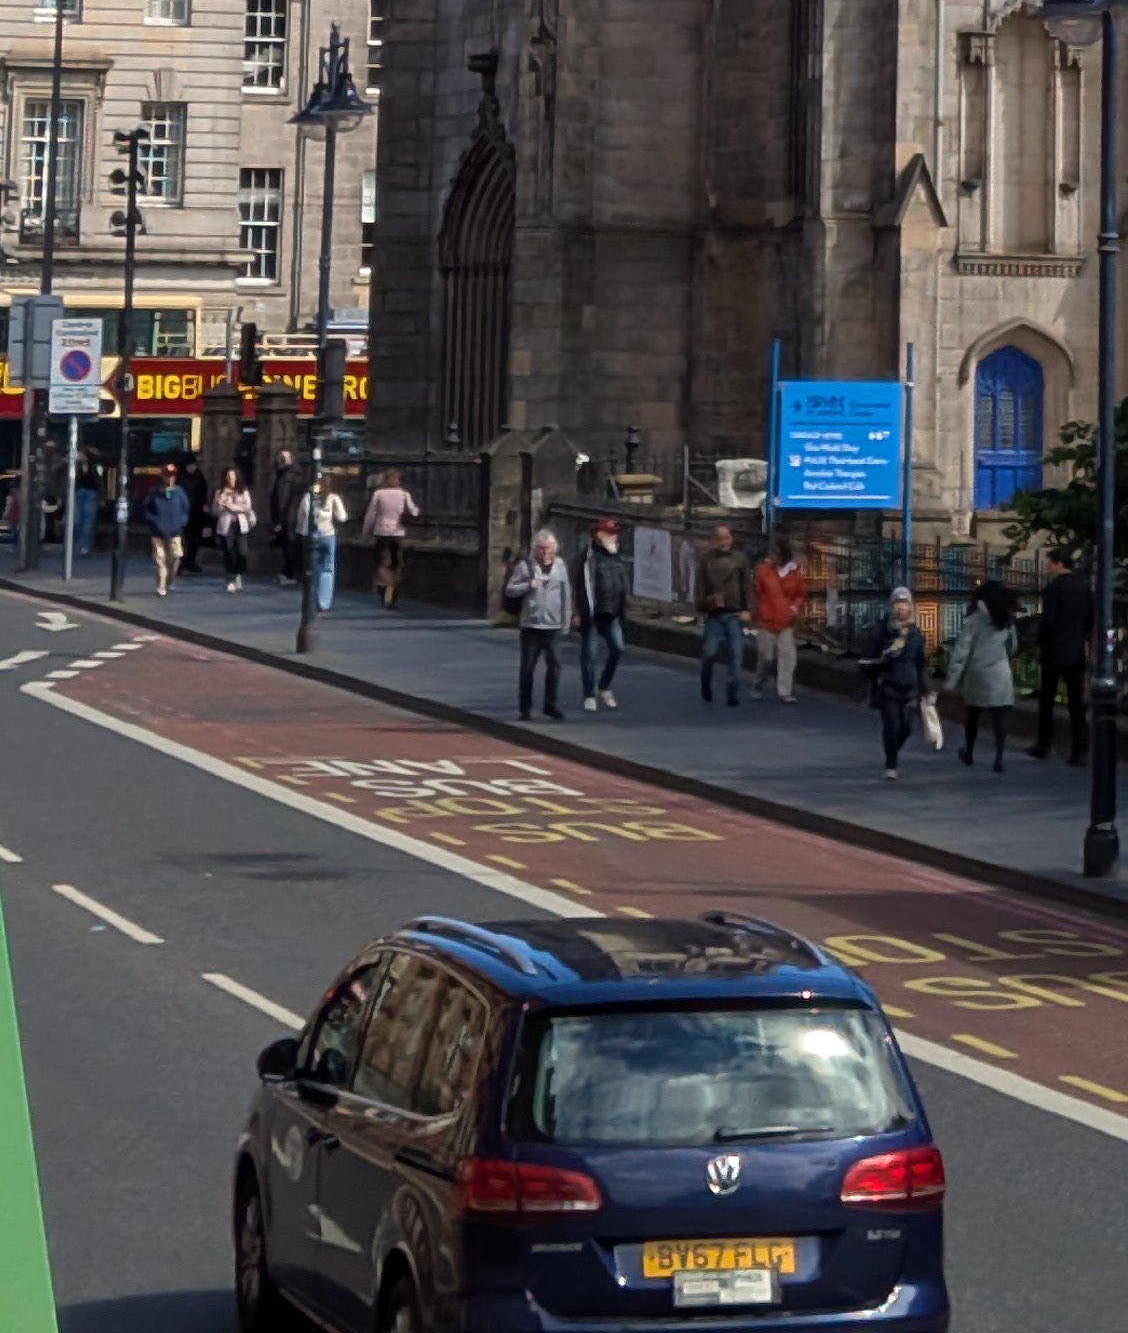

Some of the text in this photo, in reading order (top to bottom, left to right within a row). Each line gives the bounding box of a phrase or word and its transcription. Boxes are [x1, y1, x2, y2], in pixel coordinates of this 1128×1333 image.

[291, 759, 552, 777] LANE
[351, 778, 585, 798] BUS
[375, 797, 668, 824] STOP
[474, 822, 725, 844] BUS
